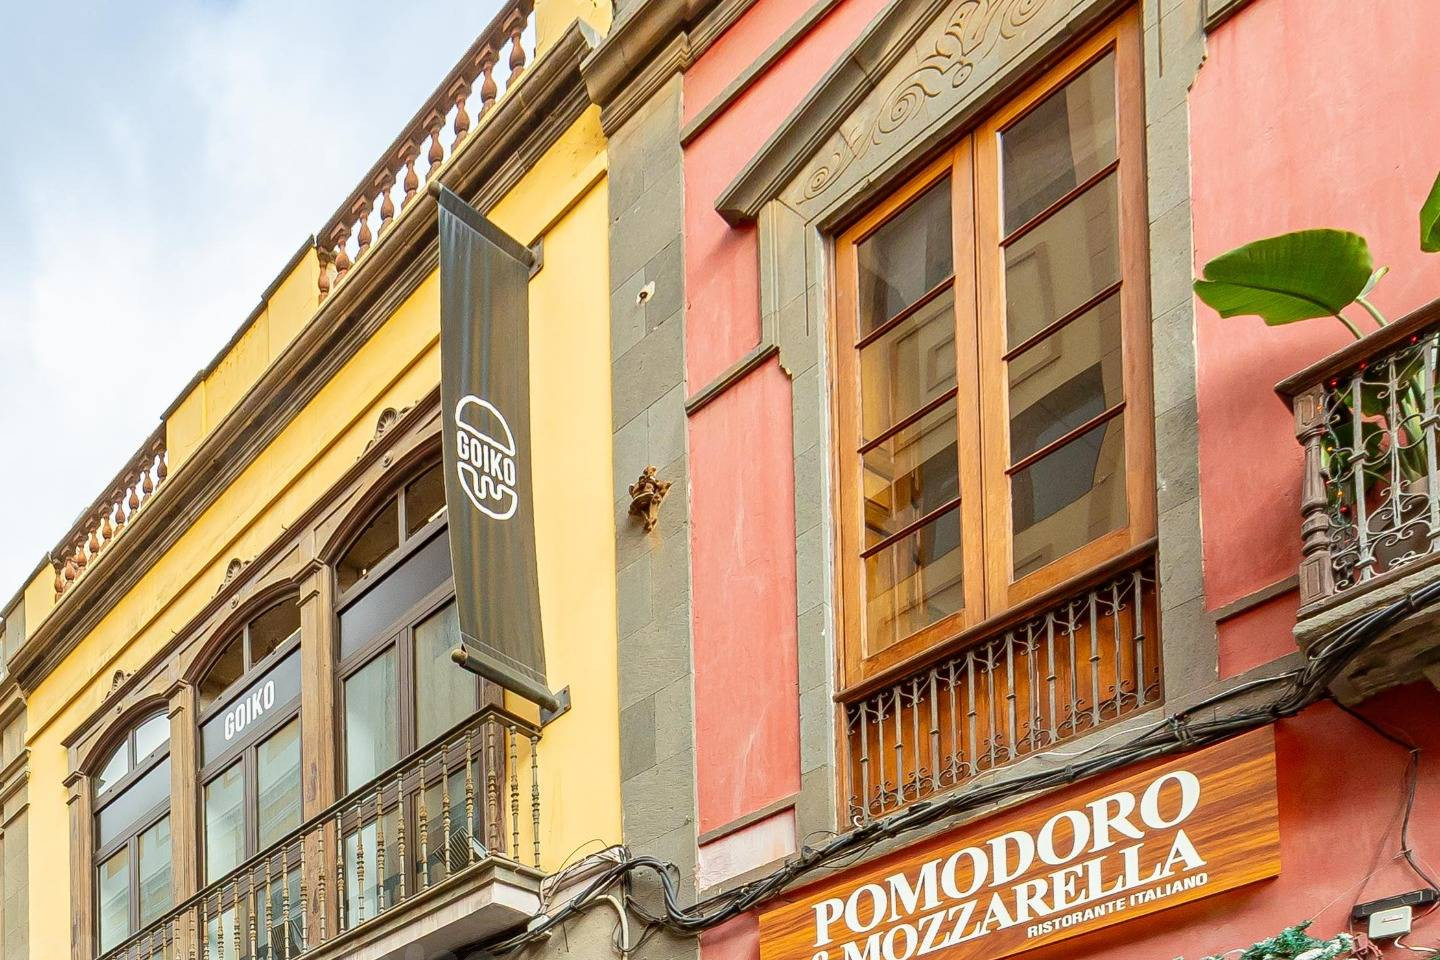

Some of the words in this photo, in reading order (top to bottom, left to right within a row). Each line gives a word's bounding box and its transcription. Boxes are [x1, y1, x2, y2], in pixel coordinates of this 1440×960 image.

[456, 430, 516, 487] GOIKO
[223, 680, 275, 741] GOIKO
[812, 770, 1202, 947] POMODORO
[1027, 898, 1127, 939] RISTORANTE
[1129, 872, 1208, 907] ITALIANO
